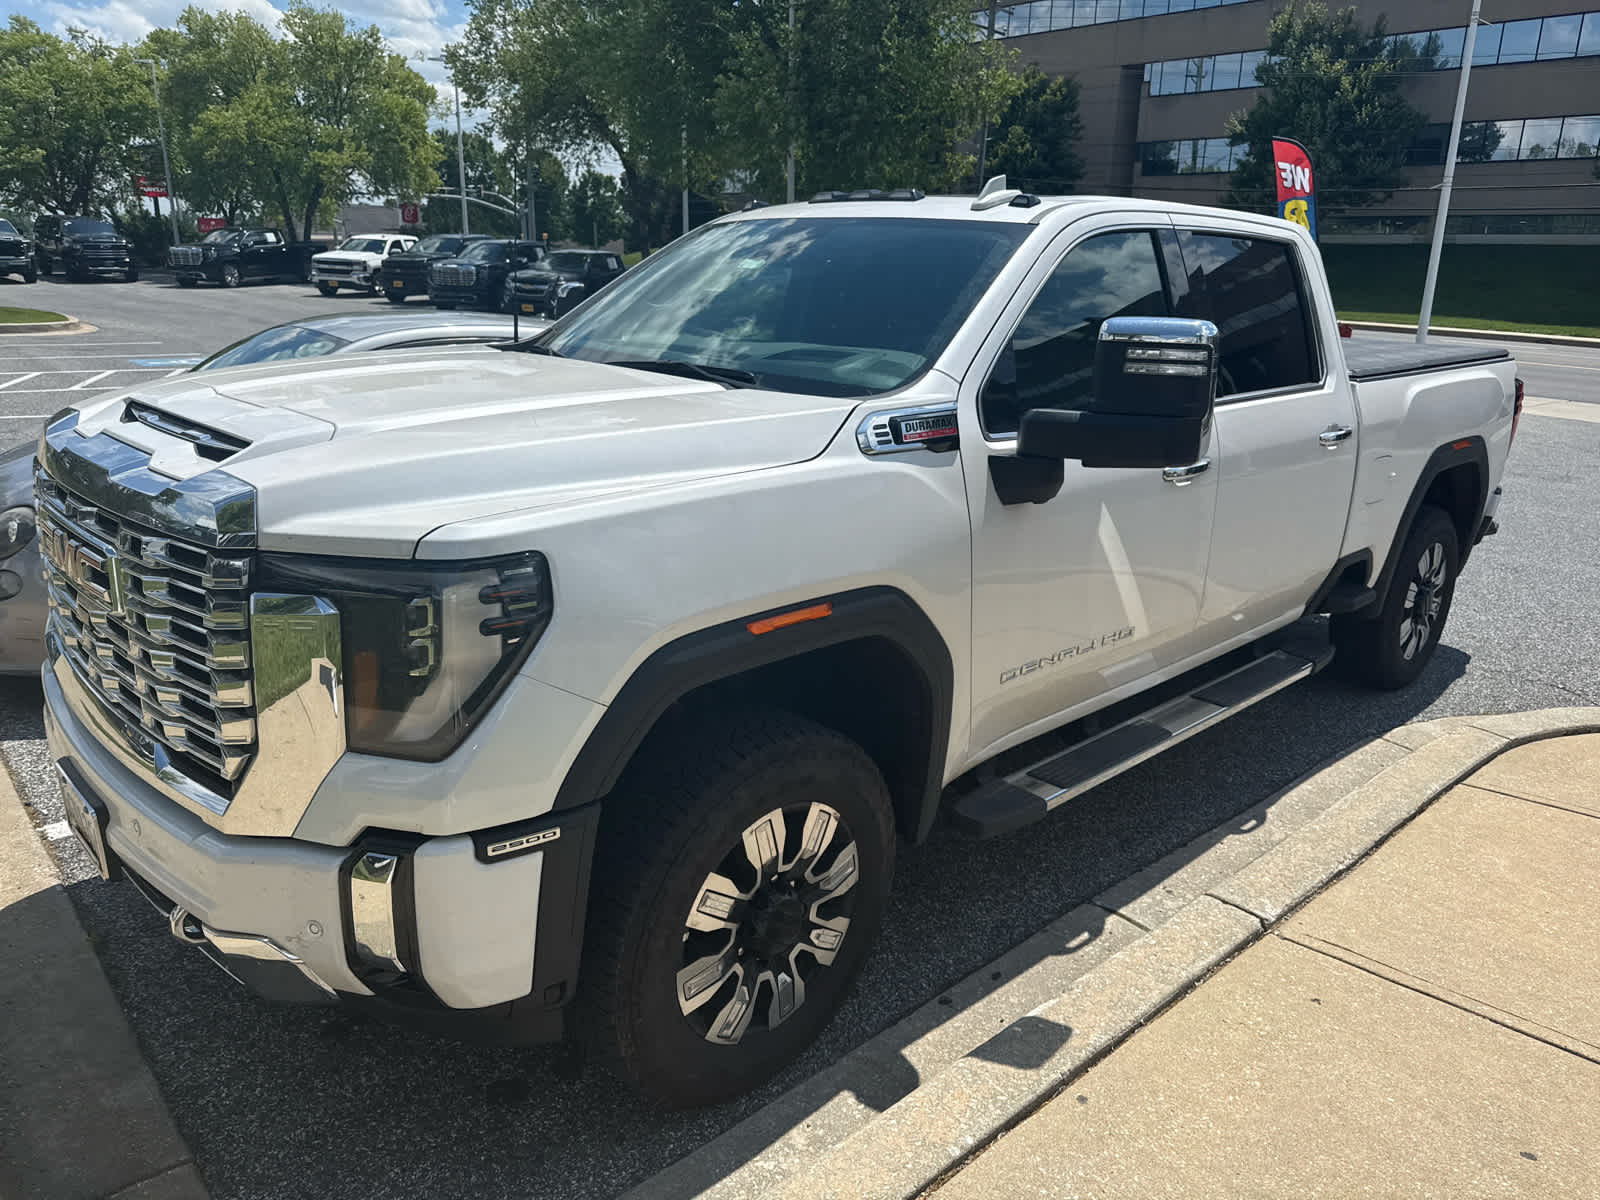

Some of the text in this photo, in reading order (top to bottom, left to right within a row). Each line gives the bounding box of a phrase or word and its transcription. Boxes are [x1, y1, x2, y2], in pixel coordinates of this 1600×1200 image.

[904, 415, 954, 433] DURAMAX
[999, 639, 1098, 684] DENALI
[490, 829, 558, 854] 2500
